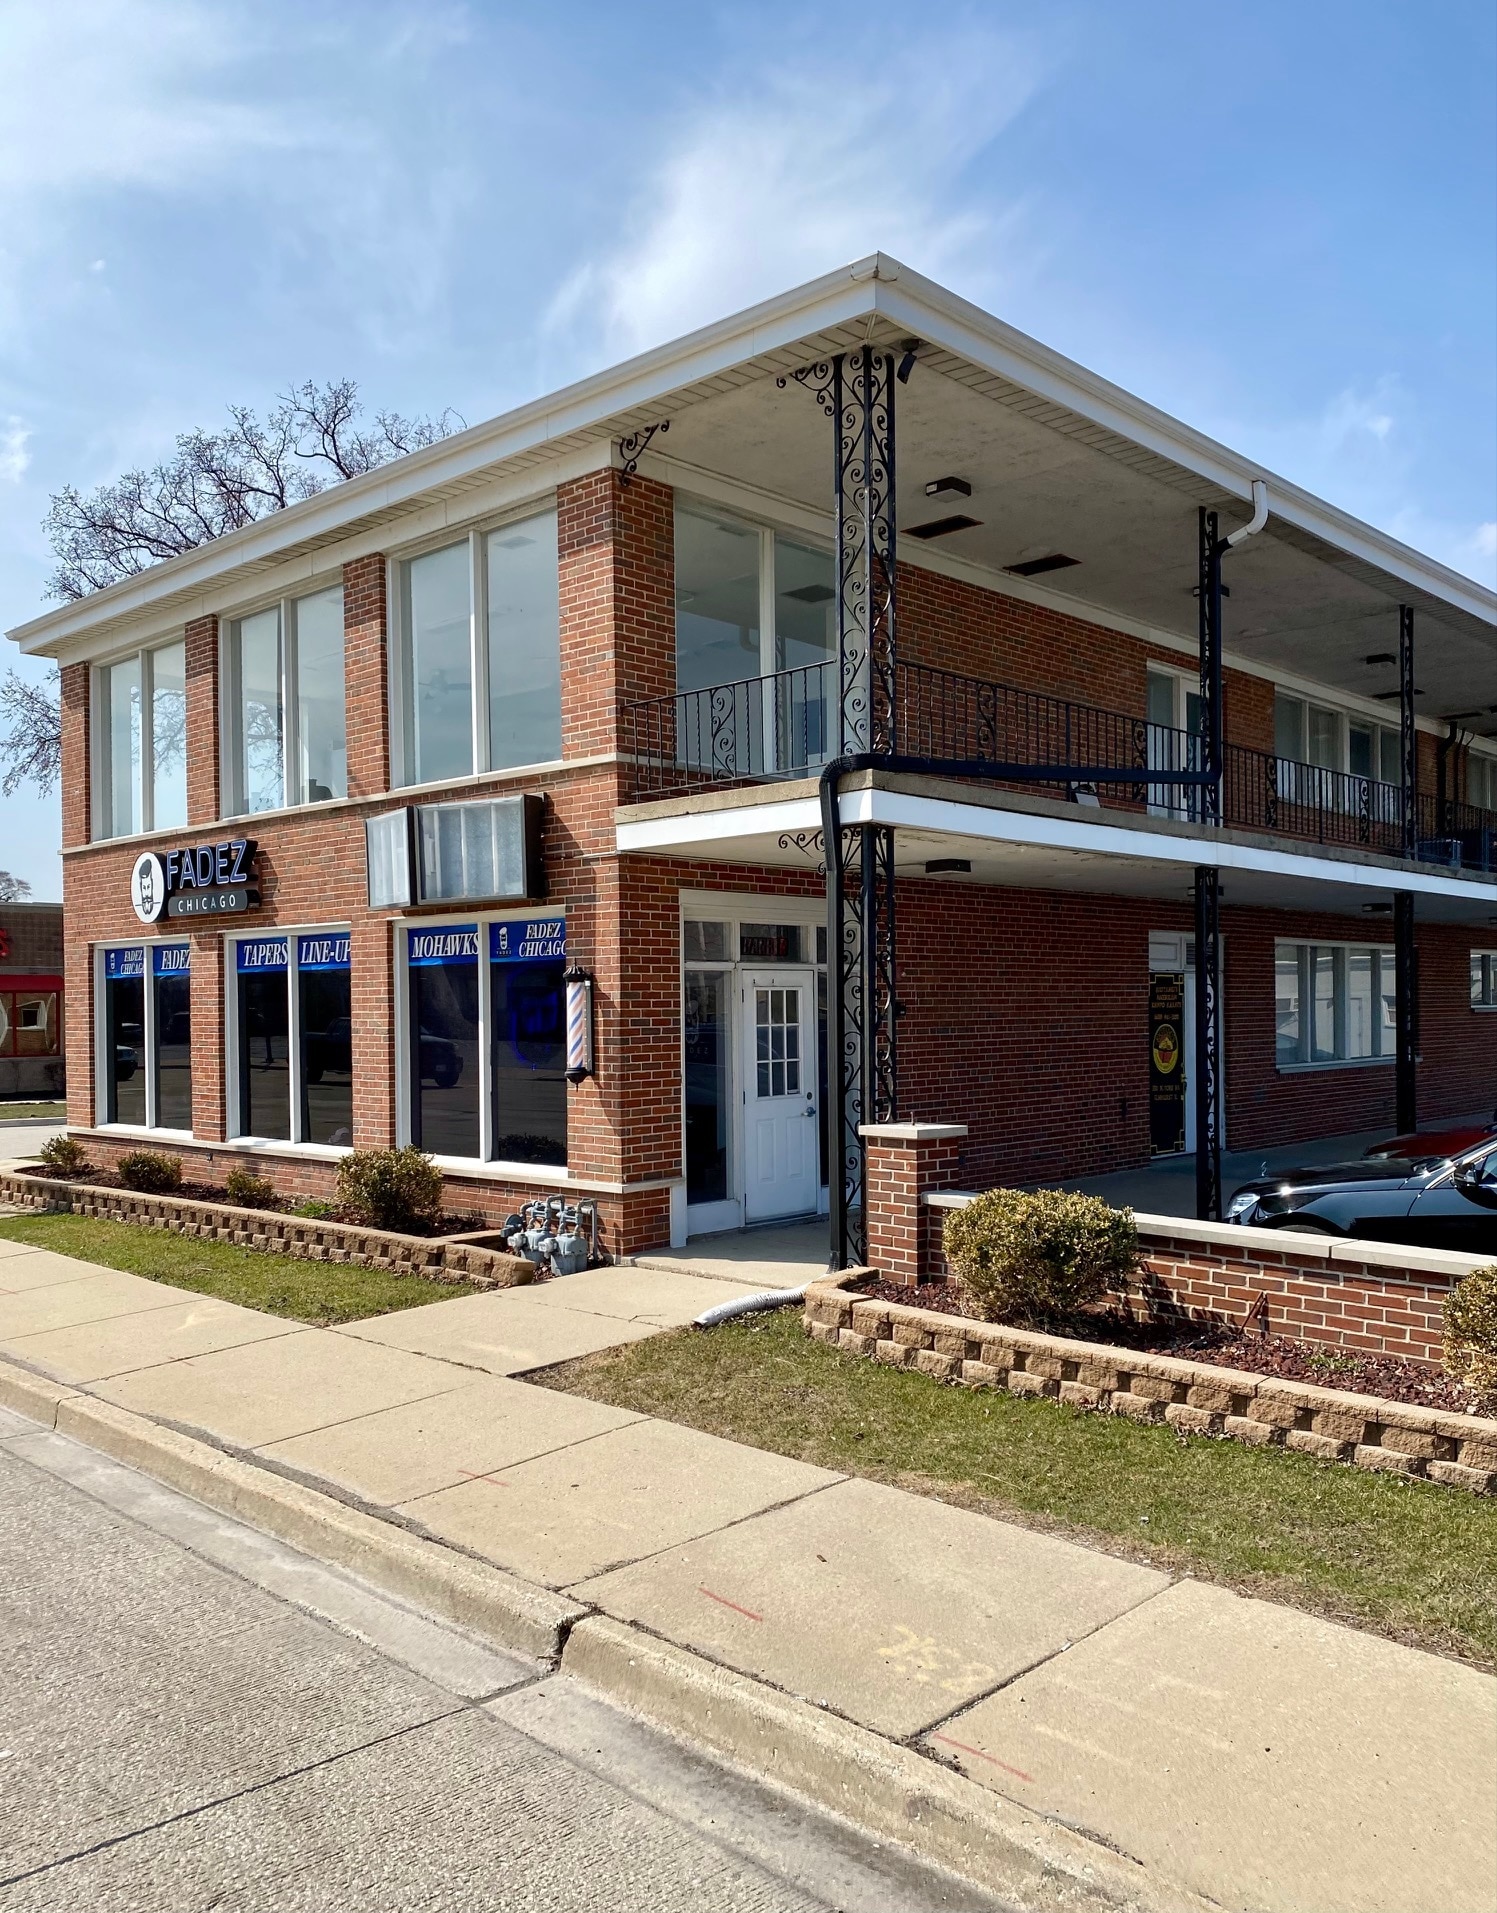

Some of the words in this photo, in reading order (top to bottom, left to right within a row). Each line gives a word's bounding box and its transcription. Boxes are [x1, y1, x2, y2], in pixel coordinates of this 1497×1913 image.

[166, 838, 247, 890] FADEZ
[178, 894, 236, 912] CHICAGO
[524, 922, 562, 940] FADEZ
[411, 932, 479, 958] MOHAWKS
[124, 949, 143, 962] FADEZ
[243, 942, 288, 967] TAPERS
[120, 962, 144, 975] CHICAG
